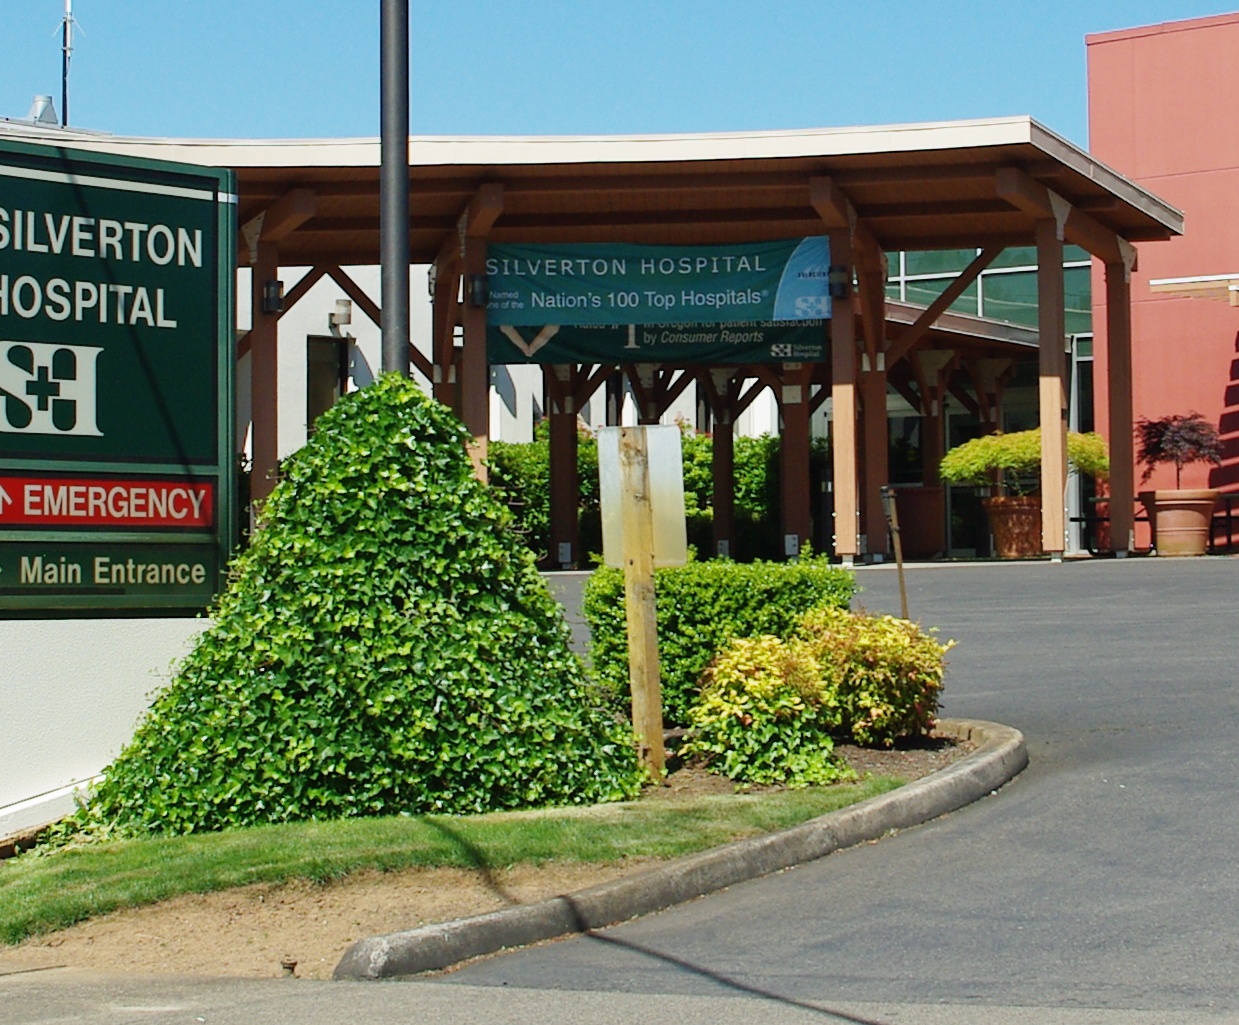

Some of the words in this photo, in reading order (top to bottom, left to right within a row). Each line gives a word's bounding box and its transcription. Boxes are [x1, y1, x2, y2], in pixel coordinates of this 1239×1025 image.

[486, 258, 627, 276] SILVERTON
[641, 255, 767, 276] HOSPITAL
[489, 290, 519, 300] Named
[500, 299, 510, 309] of
[511, 300, 525, 310] the
[531, 290, 602, 309] Nation's
[607, 291, 639, 308] 100
[644, 290, 676, 311] Top
[643, 331, 657, 345] by
[660, 330, 718, 344] Consumer
[720, 329, 764, 345] Reports
[23, 483, 208, 519] EMERGENCY
[20, 556, 82, 585] Main
[94, 556, 207, 586] Entrance
